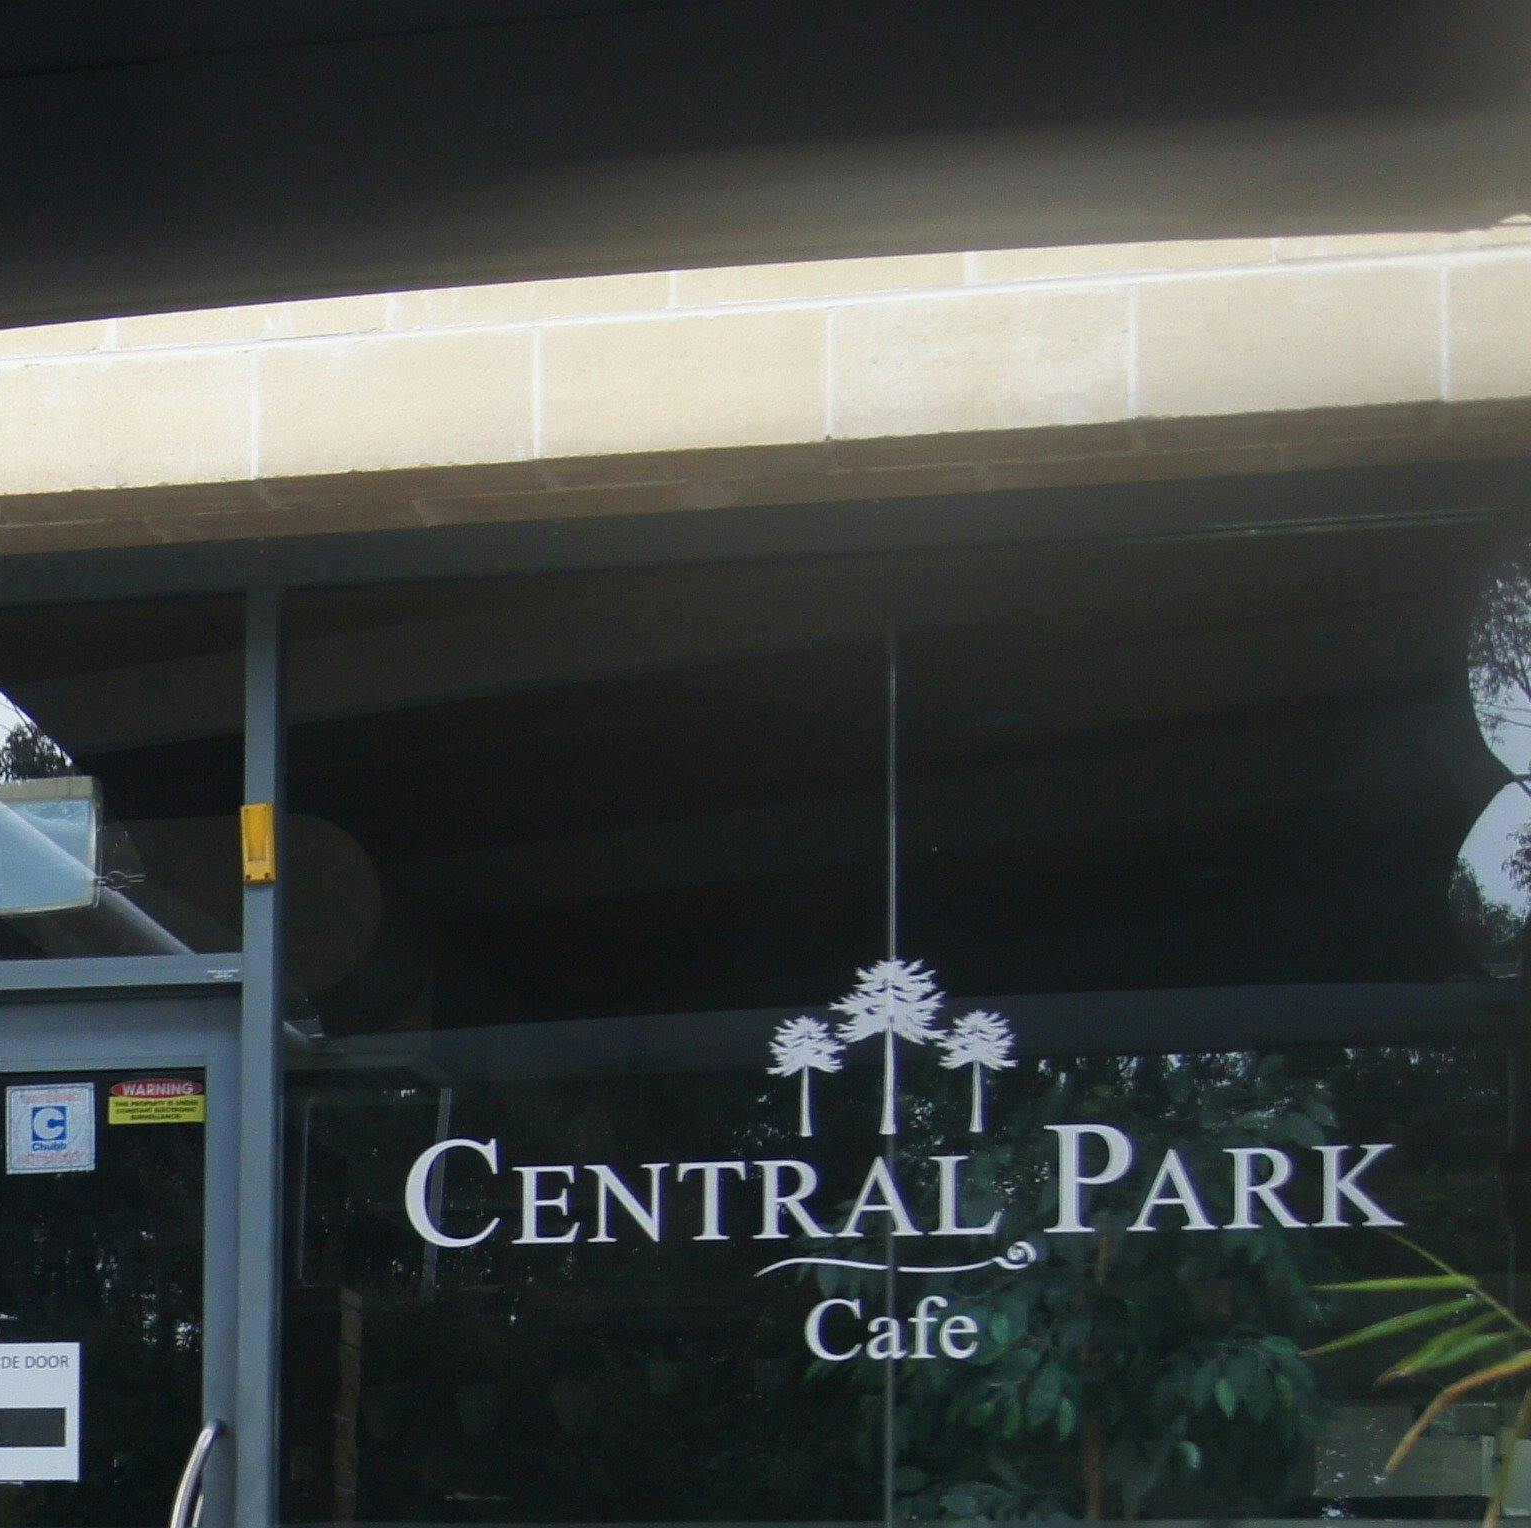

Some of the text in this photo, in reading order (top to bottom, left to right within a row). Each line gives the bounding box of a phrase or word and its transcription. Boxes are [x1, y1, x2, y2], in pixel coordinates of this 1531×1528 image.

[122, 1082, 194, 1096] WARNING
[31, 1142, 67, 1152] Chubb
[404, 1123, 1406, 1247] CENTRAL PARK
[804, 1293, 980, 1361] Cafe
[25, 1355, 69, 1368] DOOR
